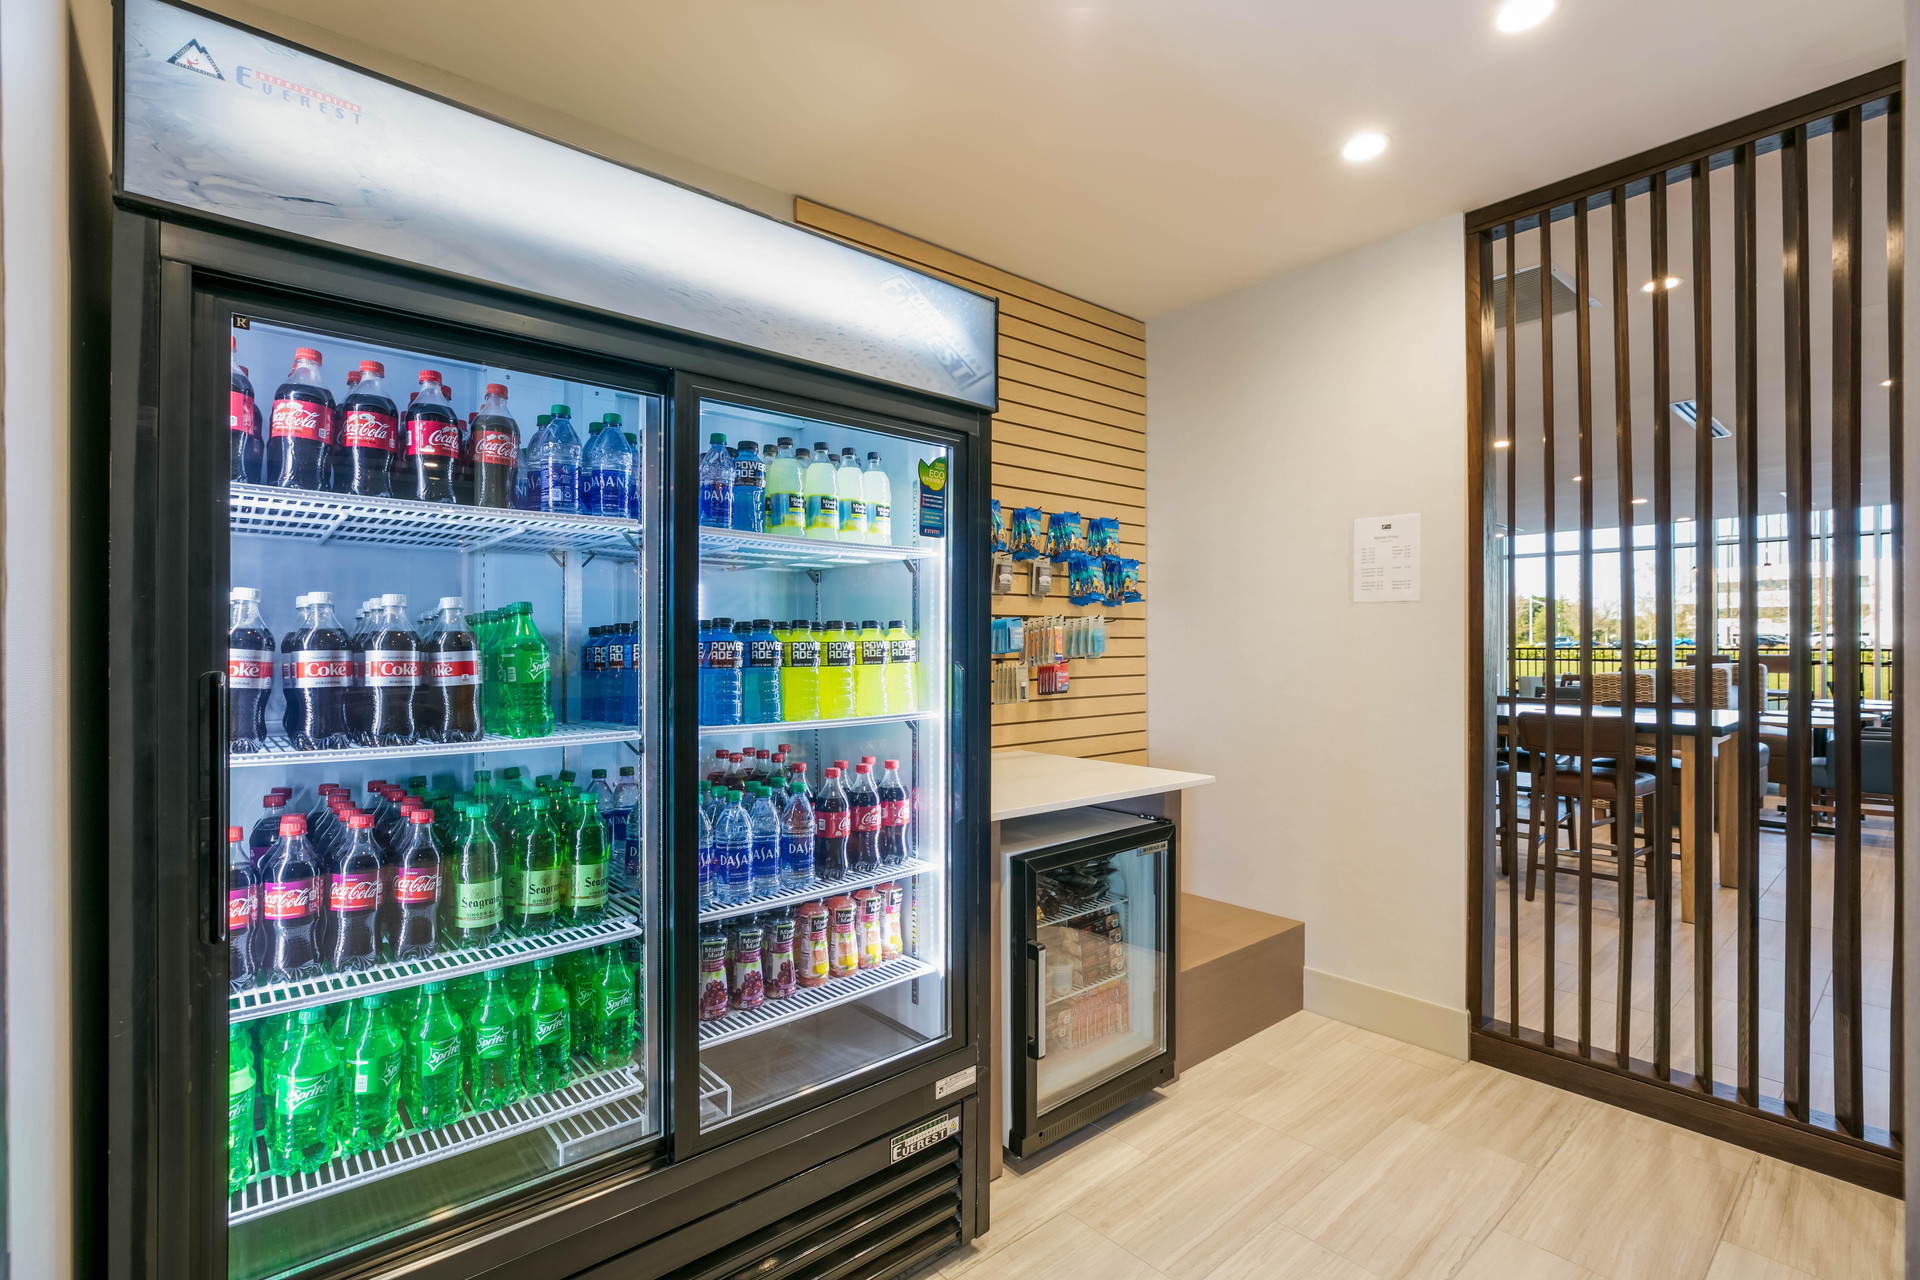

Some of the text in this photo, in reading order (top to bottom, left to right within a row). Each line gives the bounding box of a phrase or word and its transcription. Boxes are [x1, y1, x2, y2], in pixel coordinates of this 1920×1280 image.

[929, 469, 945, 479] ECO
[711, 650, 732, 660] ADE
[751, 650, 772, 660] ADE
[792, 650, 813, 660] ADE
[828, 650, 849, 659] ADE
[863, 648, 883, 658] ADE
[891, 648, 910, 657] ADE
[305, 662, 347, 677] Coke
[380, 662, 418, 676] Coke
[477, 1034, 505, 1048] Sprite
